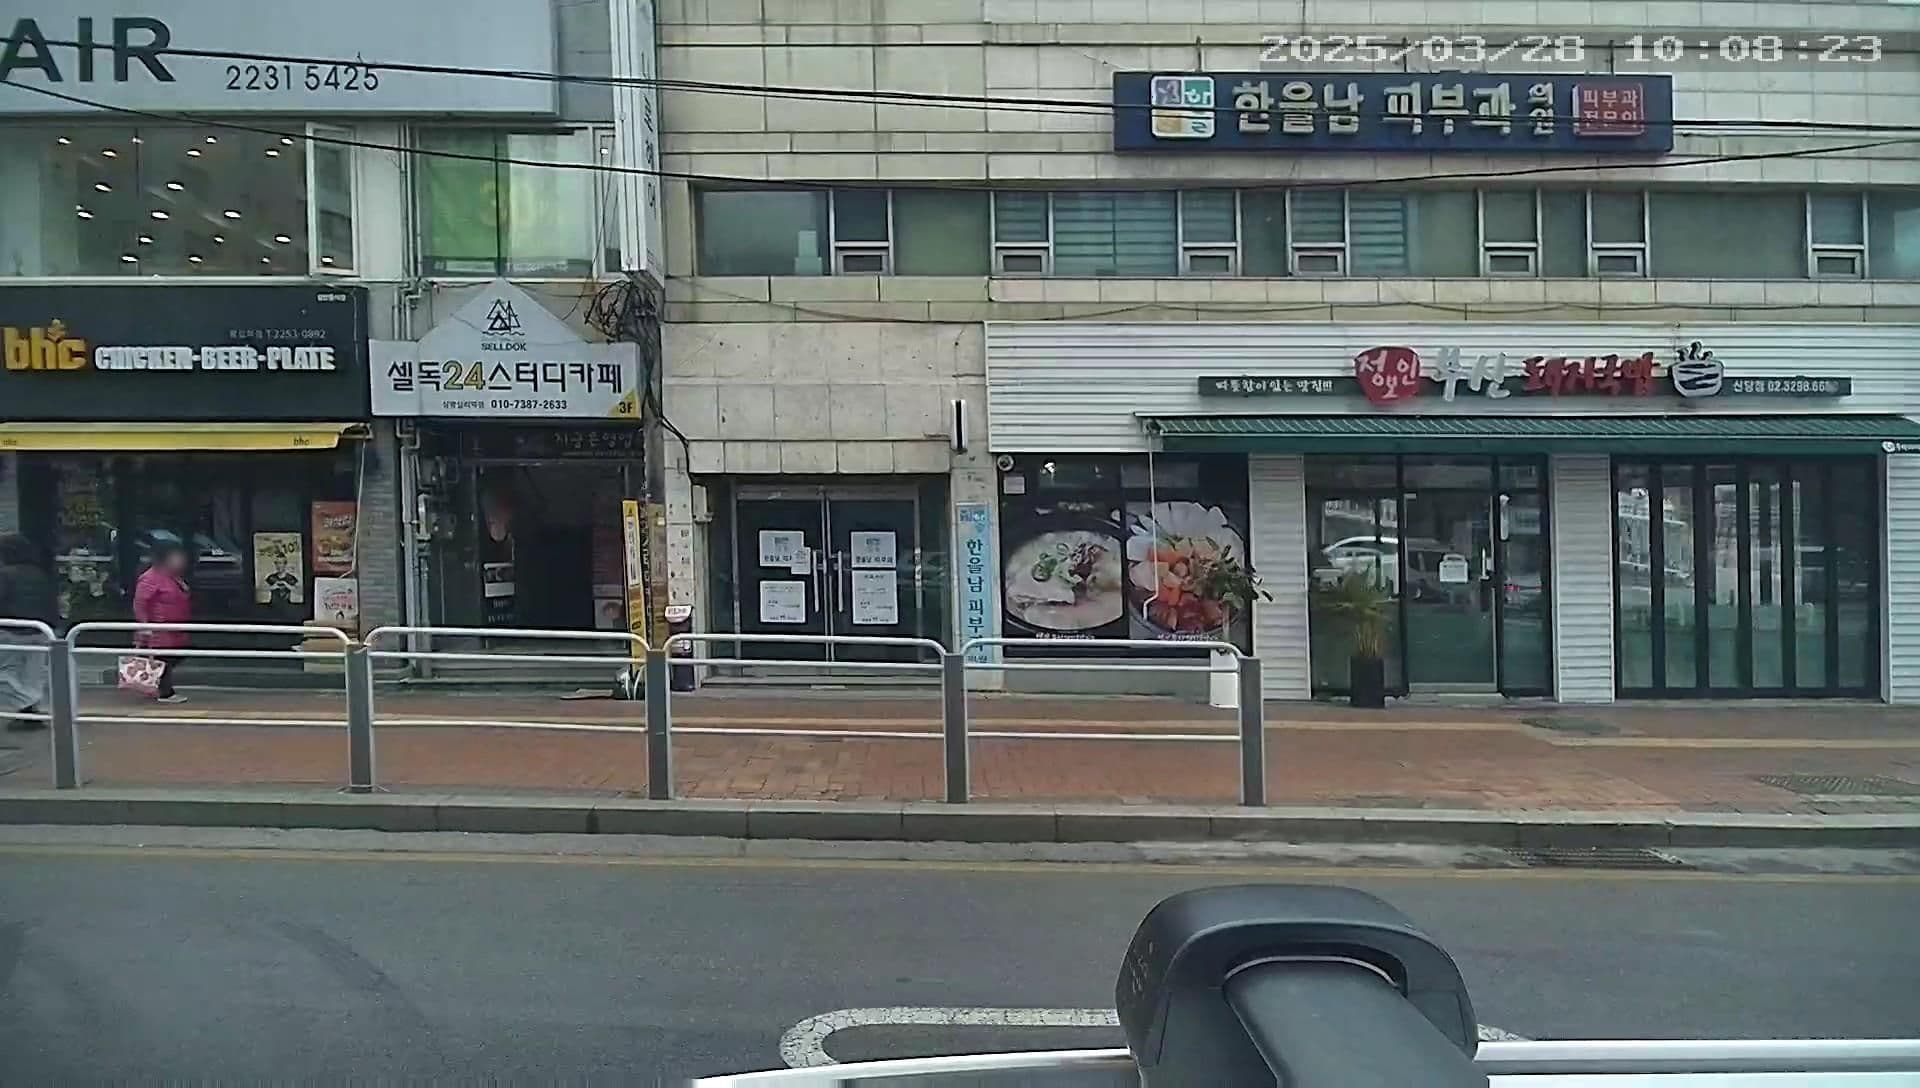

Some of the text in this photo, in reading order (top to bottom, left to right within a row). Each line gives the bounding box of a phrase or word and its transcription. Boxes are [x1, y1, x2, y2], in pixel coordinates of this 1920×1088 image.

[0, 16, 177, 83] AIR
[225, 62, 381, 92] 2231 5425
[1231, 79, 1364, 135] 한을남
[1383, 80, 1517, 136] 피부과
[1583, 89, 1638, 109] 피부과
[3, 326, 88, 370] bhc
[481, 342, 527, 352] SELLDOK
[387, 360, 622, 394] 셀독24스터디카페
[1431, 345, 1512, 402] 부산
[490, 399, 568, 411] 010-7387-2633
[618, 401, 634, 415] 3F
[966, 538, 986, 593] 한을남
